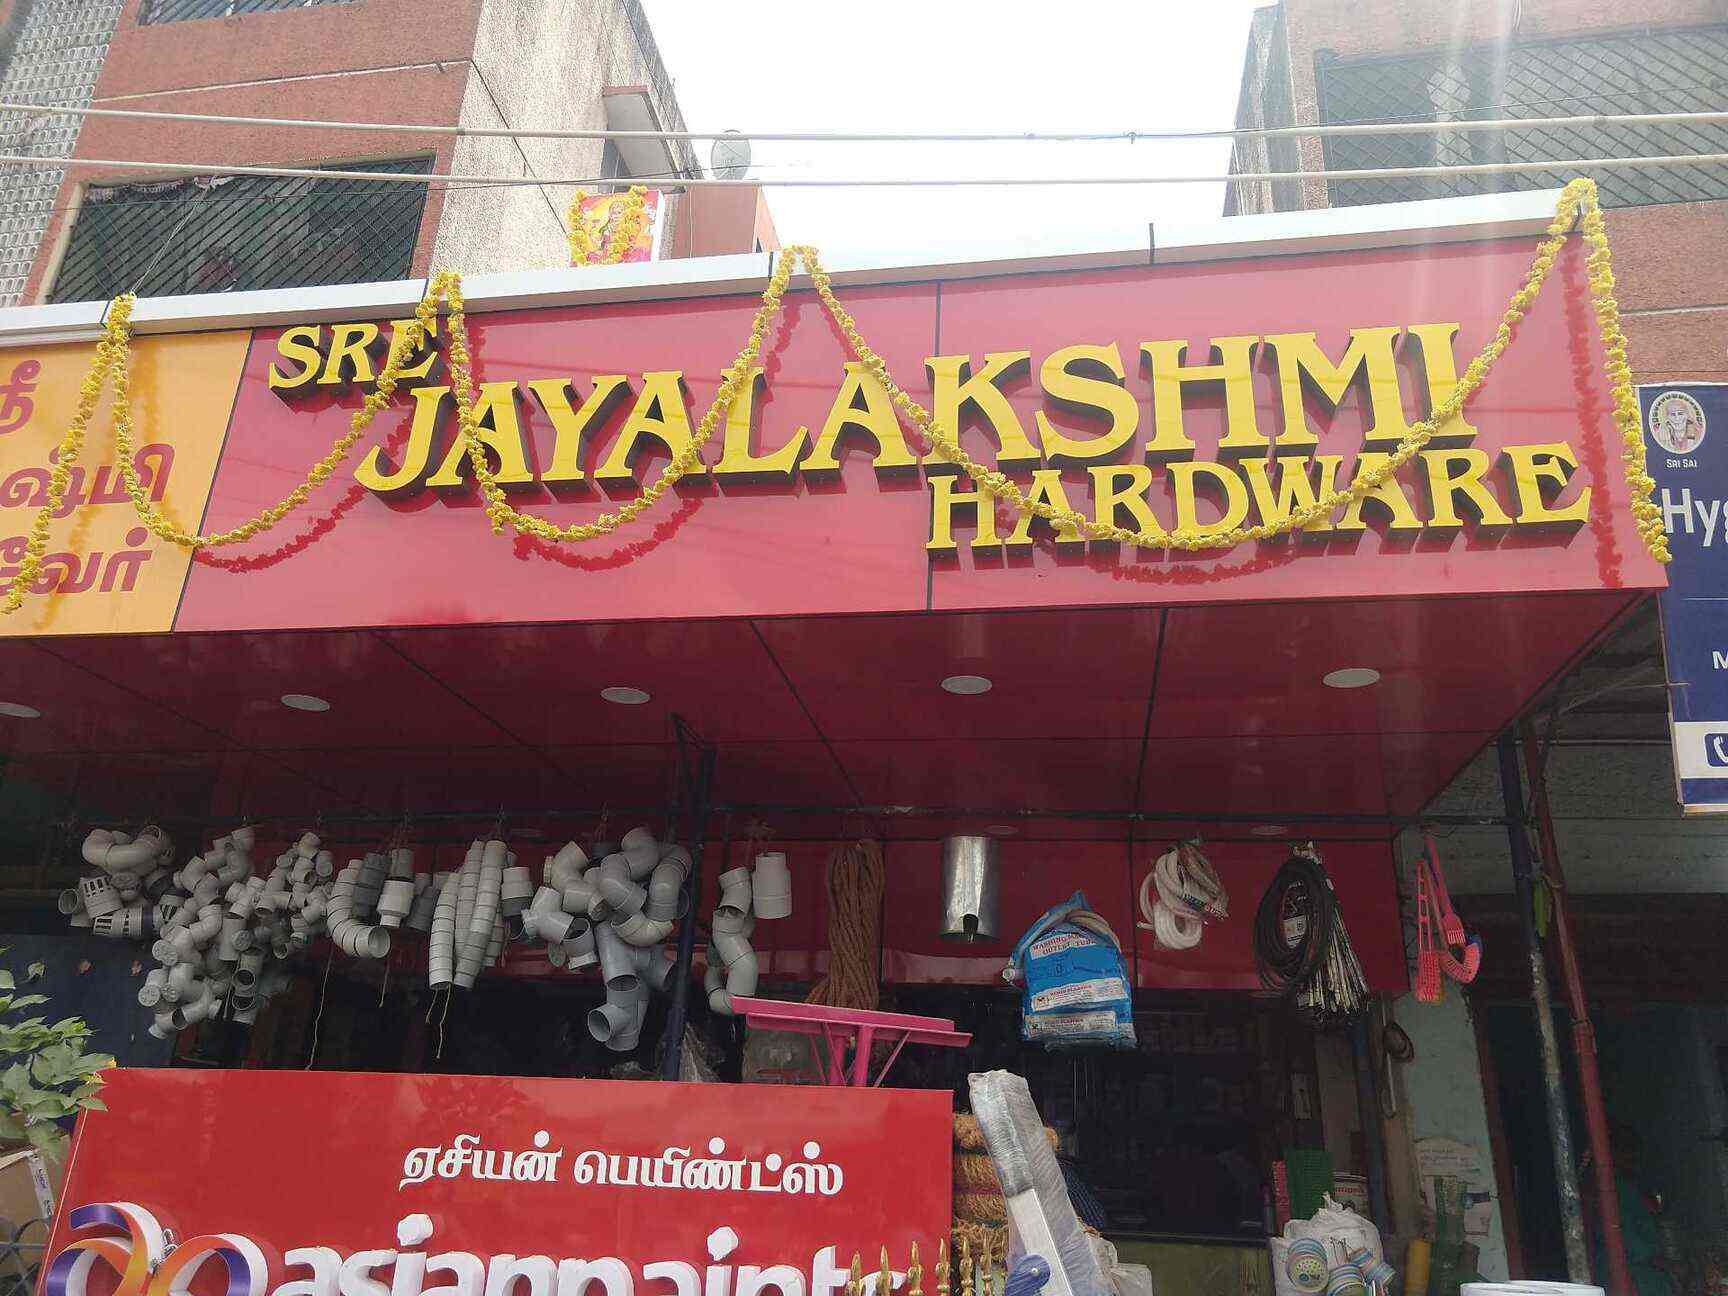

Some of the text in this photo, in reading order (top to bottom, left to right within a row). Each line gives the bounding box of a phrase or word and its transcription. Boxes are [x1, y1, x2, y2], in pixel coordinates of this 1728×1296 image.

[269, 318, 438, 389] SRE
[354, 322, 1478, 491] JAYALAKSHMI
[926, 441, 1592, 550] HARDWARE
[1666, 458, 1681, 468] SRI
[1661, 488, 1728, 547] Hy
[399, 1130, 844, 1195] ஏசியன் பெயிண்ட்ஸ்
[272, 1213, 908, 1296] asianaint
